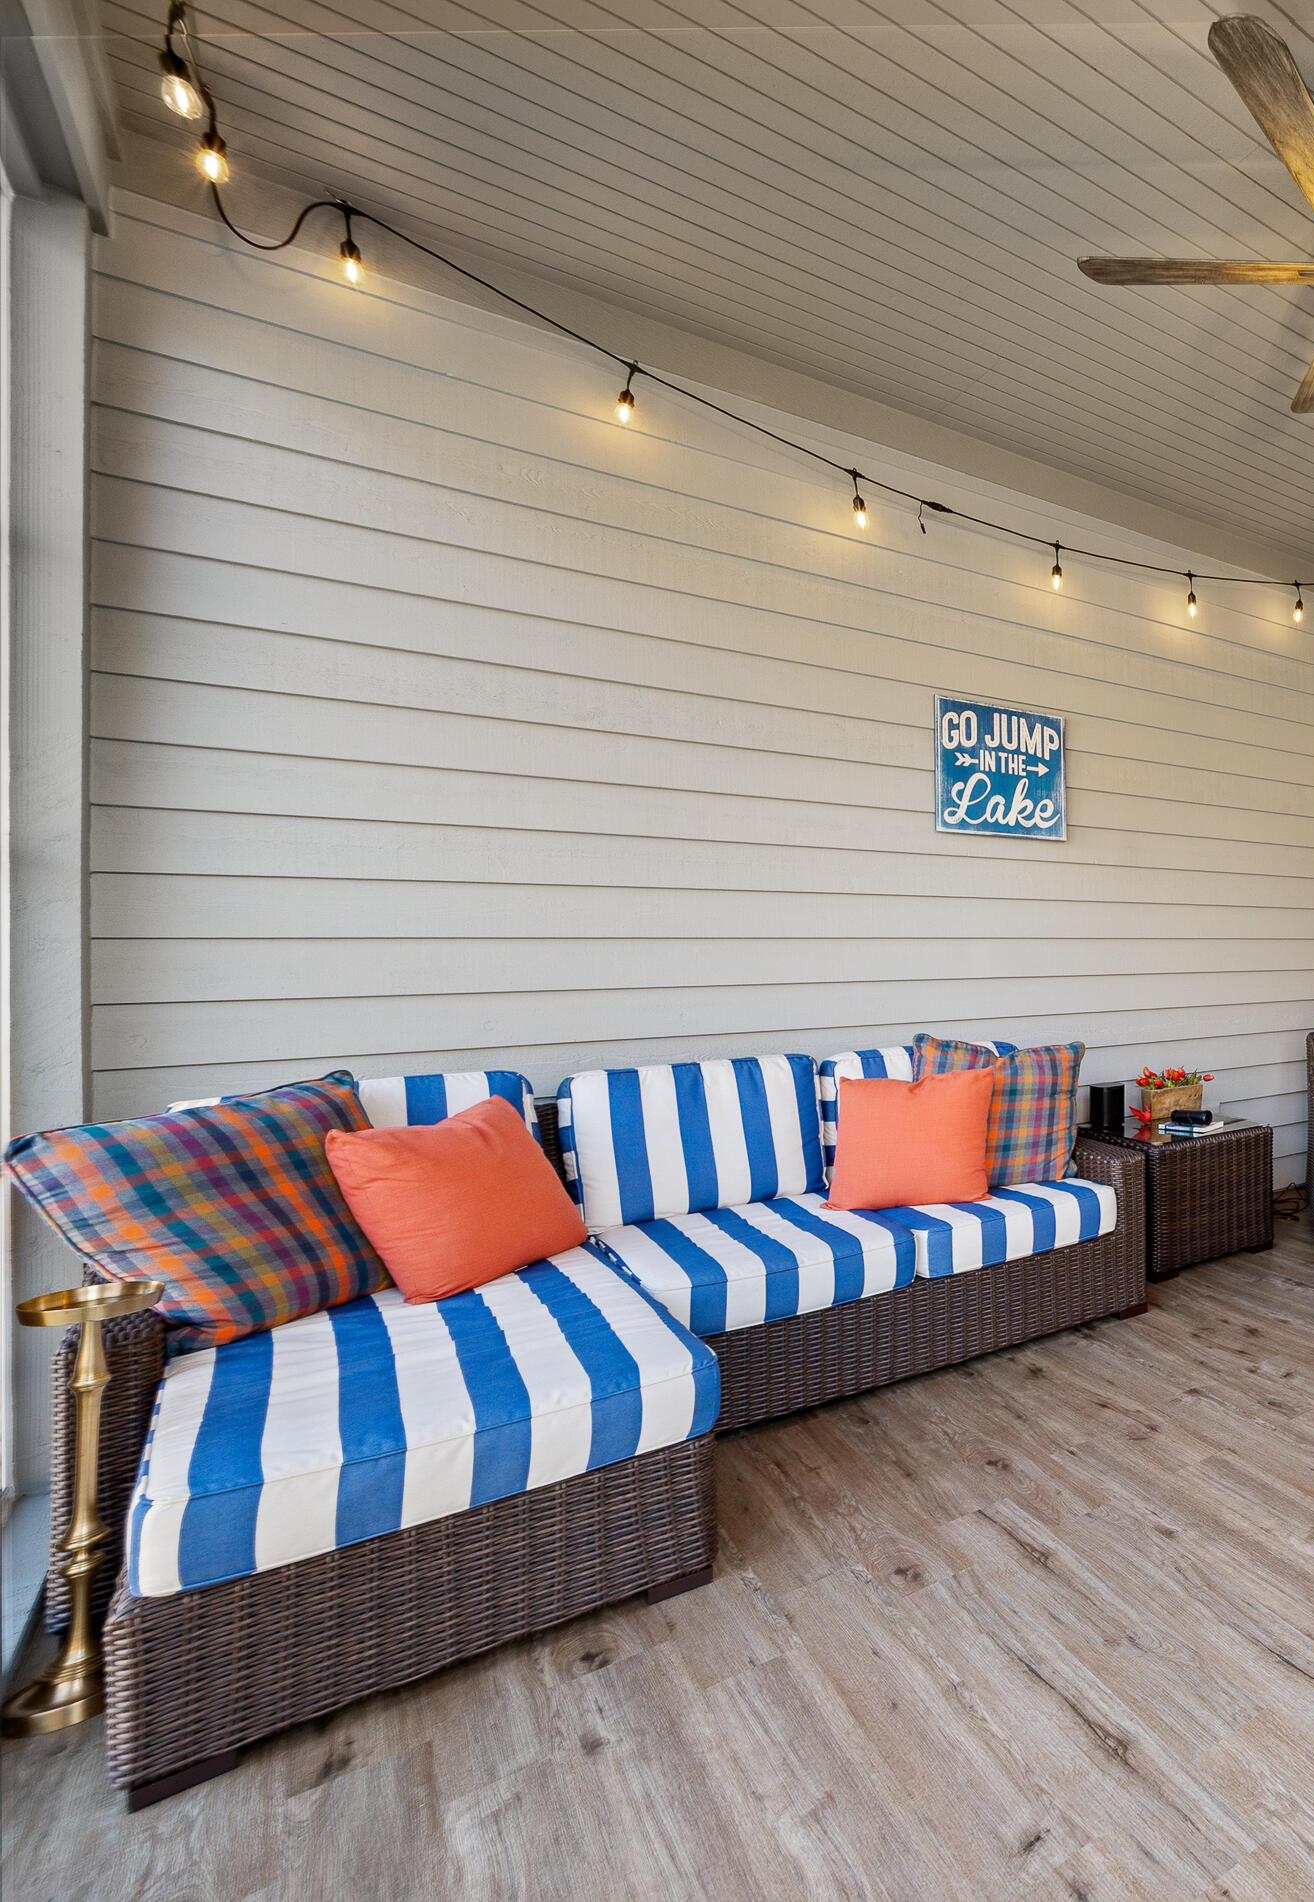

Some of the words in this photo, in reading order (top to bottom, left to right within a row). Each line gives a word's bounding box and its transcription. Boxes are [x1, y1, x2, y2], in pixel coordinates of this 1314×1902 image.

[942, 710, 978, 750] GO
[984, 712, 1060, 761] JUMP
[979, 749, 997, 773] IN
[998, 752, 1027, 777] THE
[943, 772, 1061, 829] Lake
